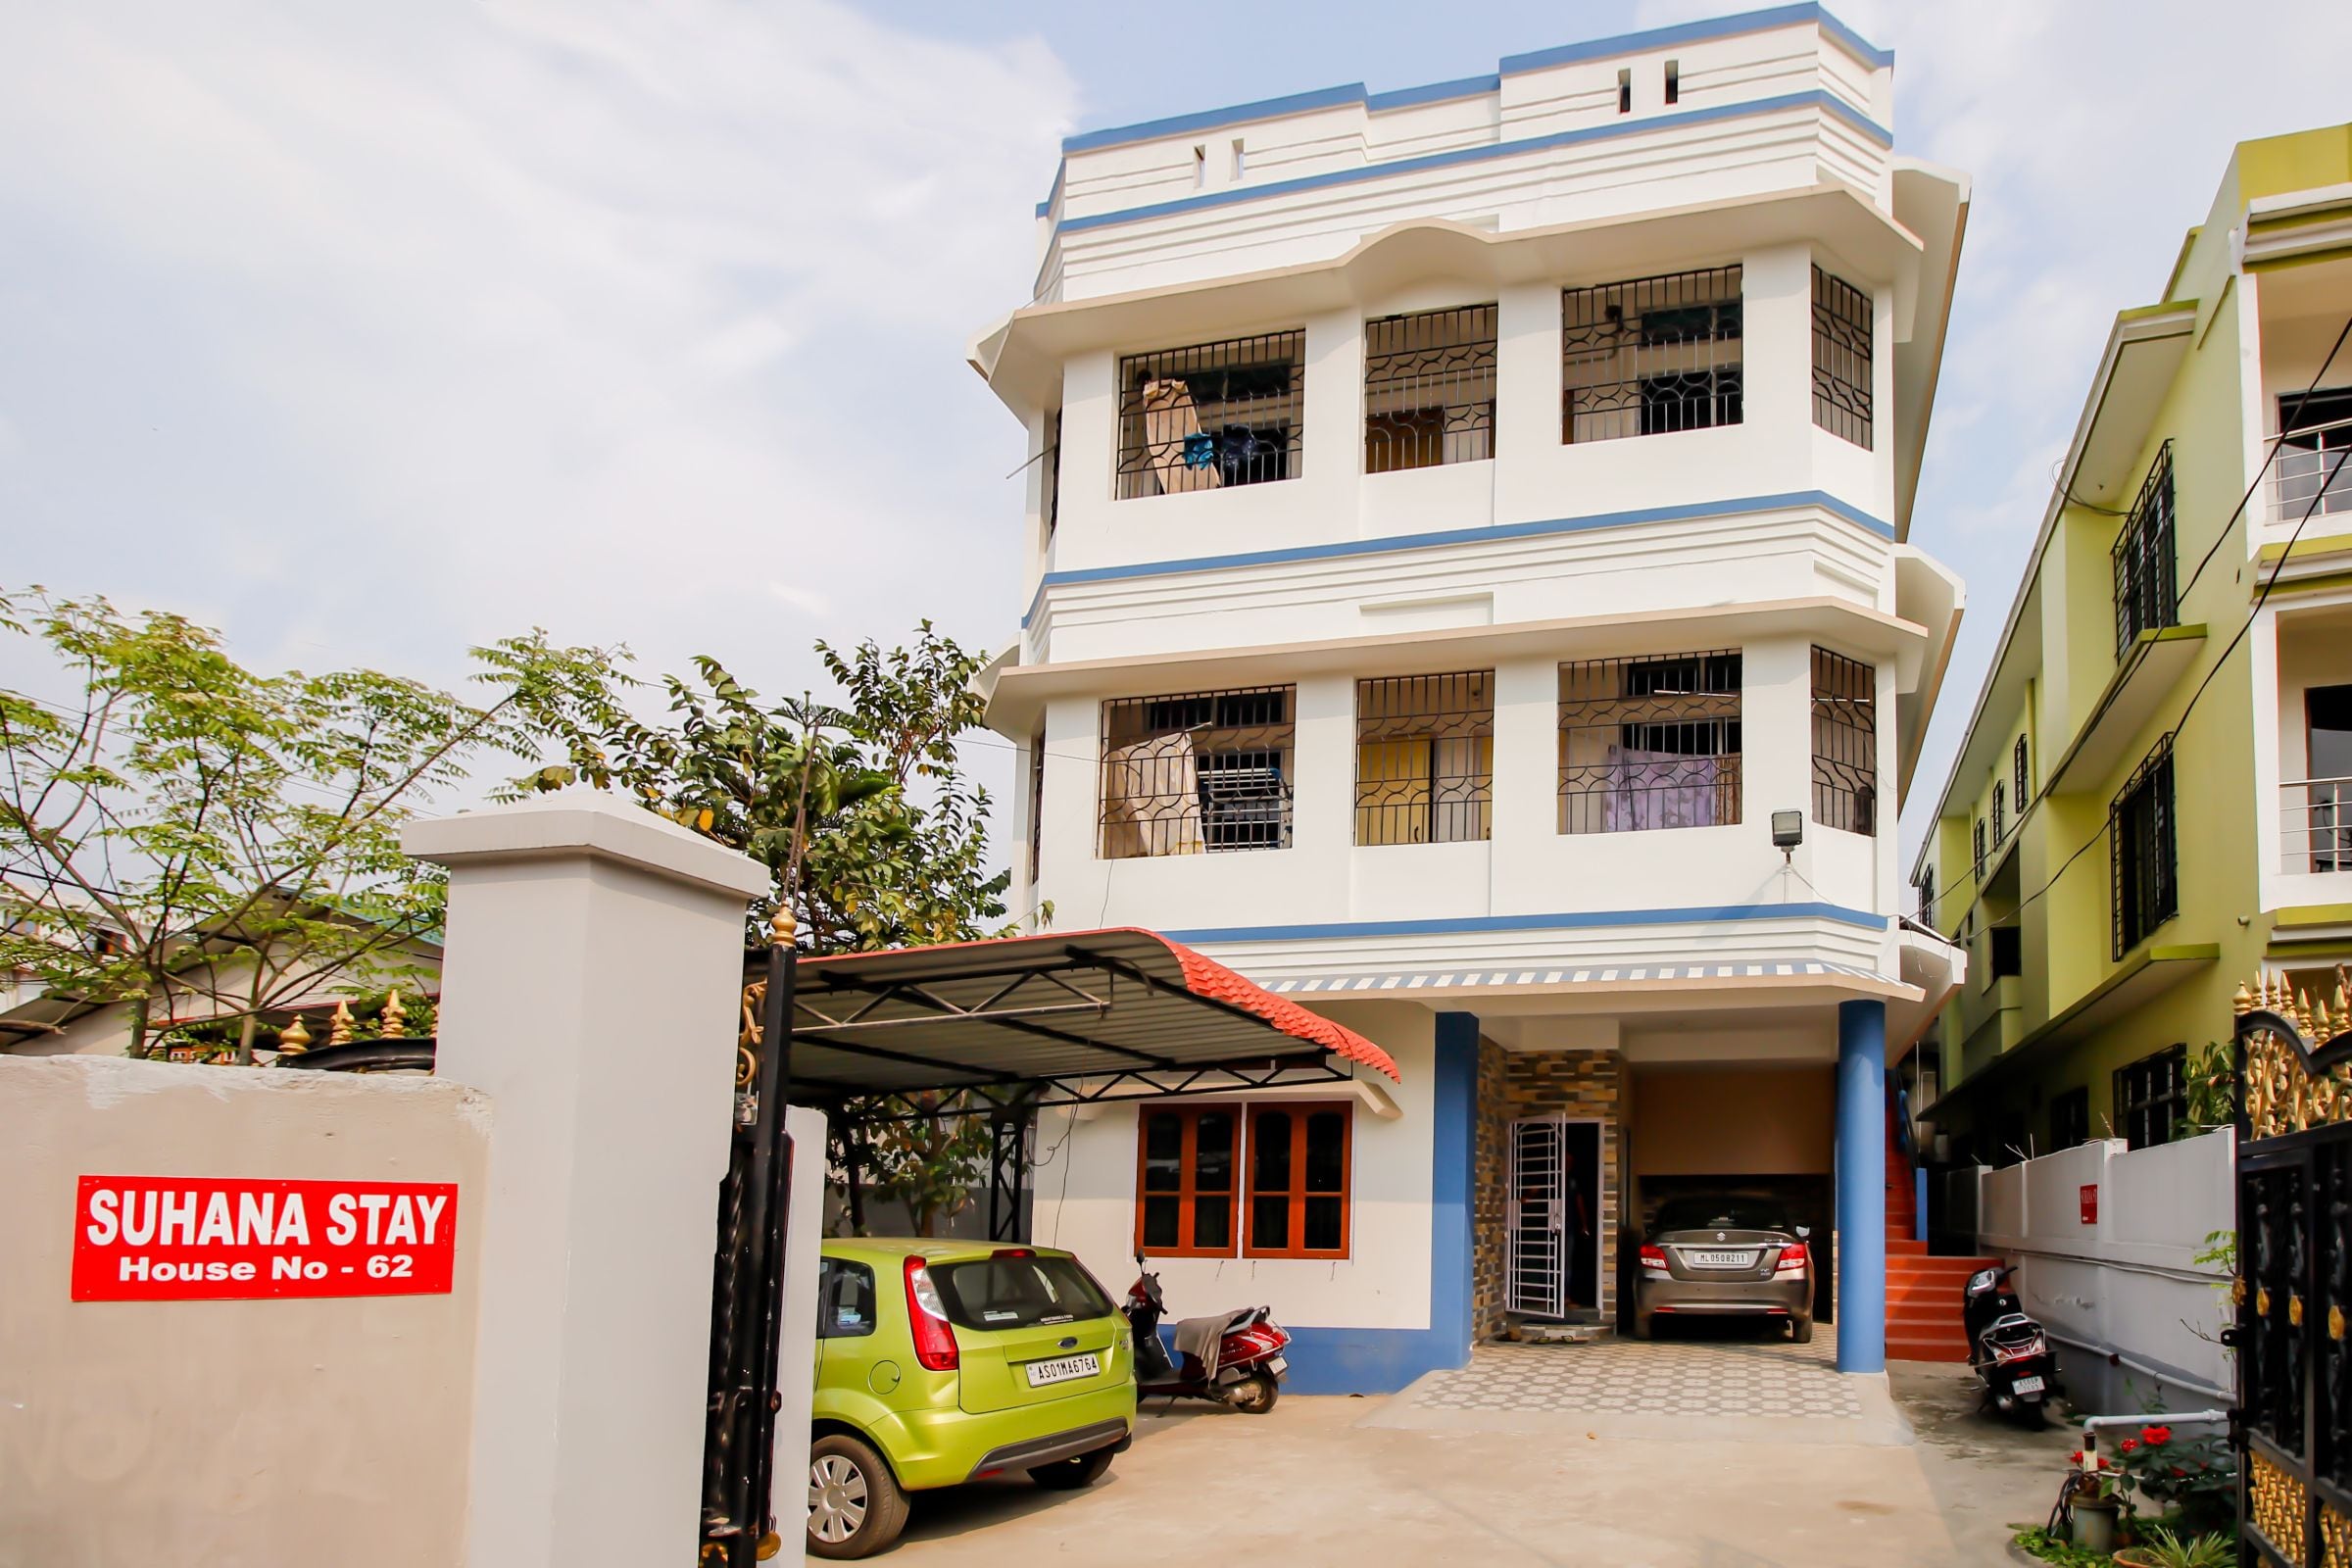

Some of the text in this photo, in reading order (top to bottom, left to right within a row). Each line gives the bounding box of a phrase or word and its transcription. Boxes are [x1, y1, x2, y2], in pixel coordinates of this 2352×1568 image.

[86, 1189, 448, 1247] SUHANA STAY
[119, 1256, 257, 1282] House
[271, 1255, 328, 1280] No
[367, 1254, 414, 1278] 62
